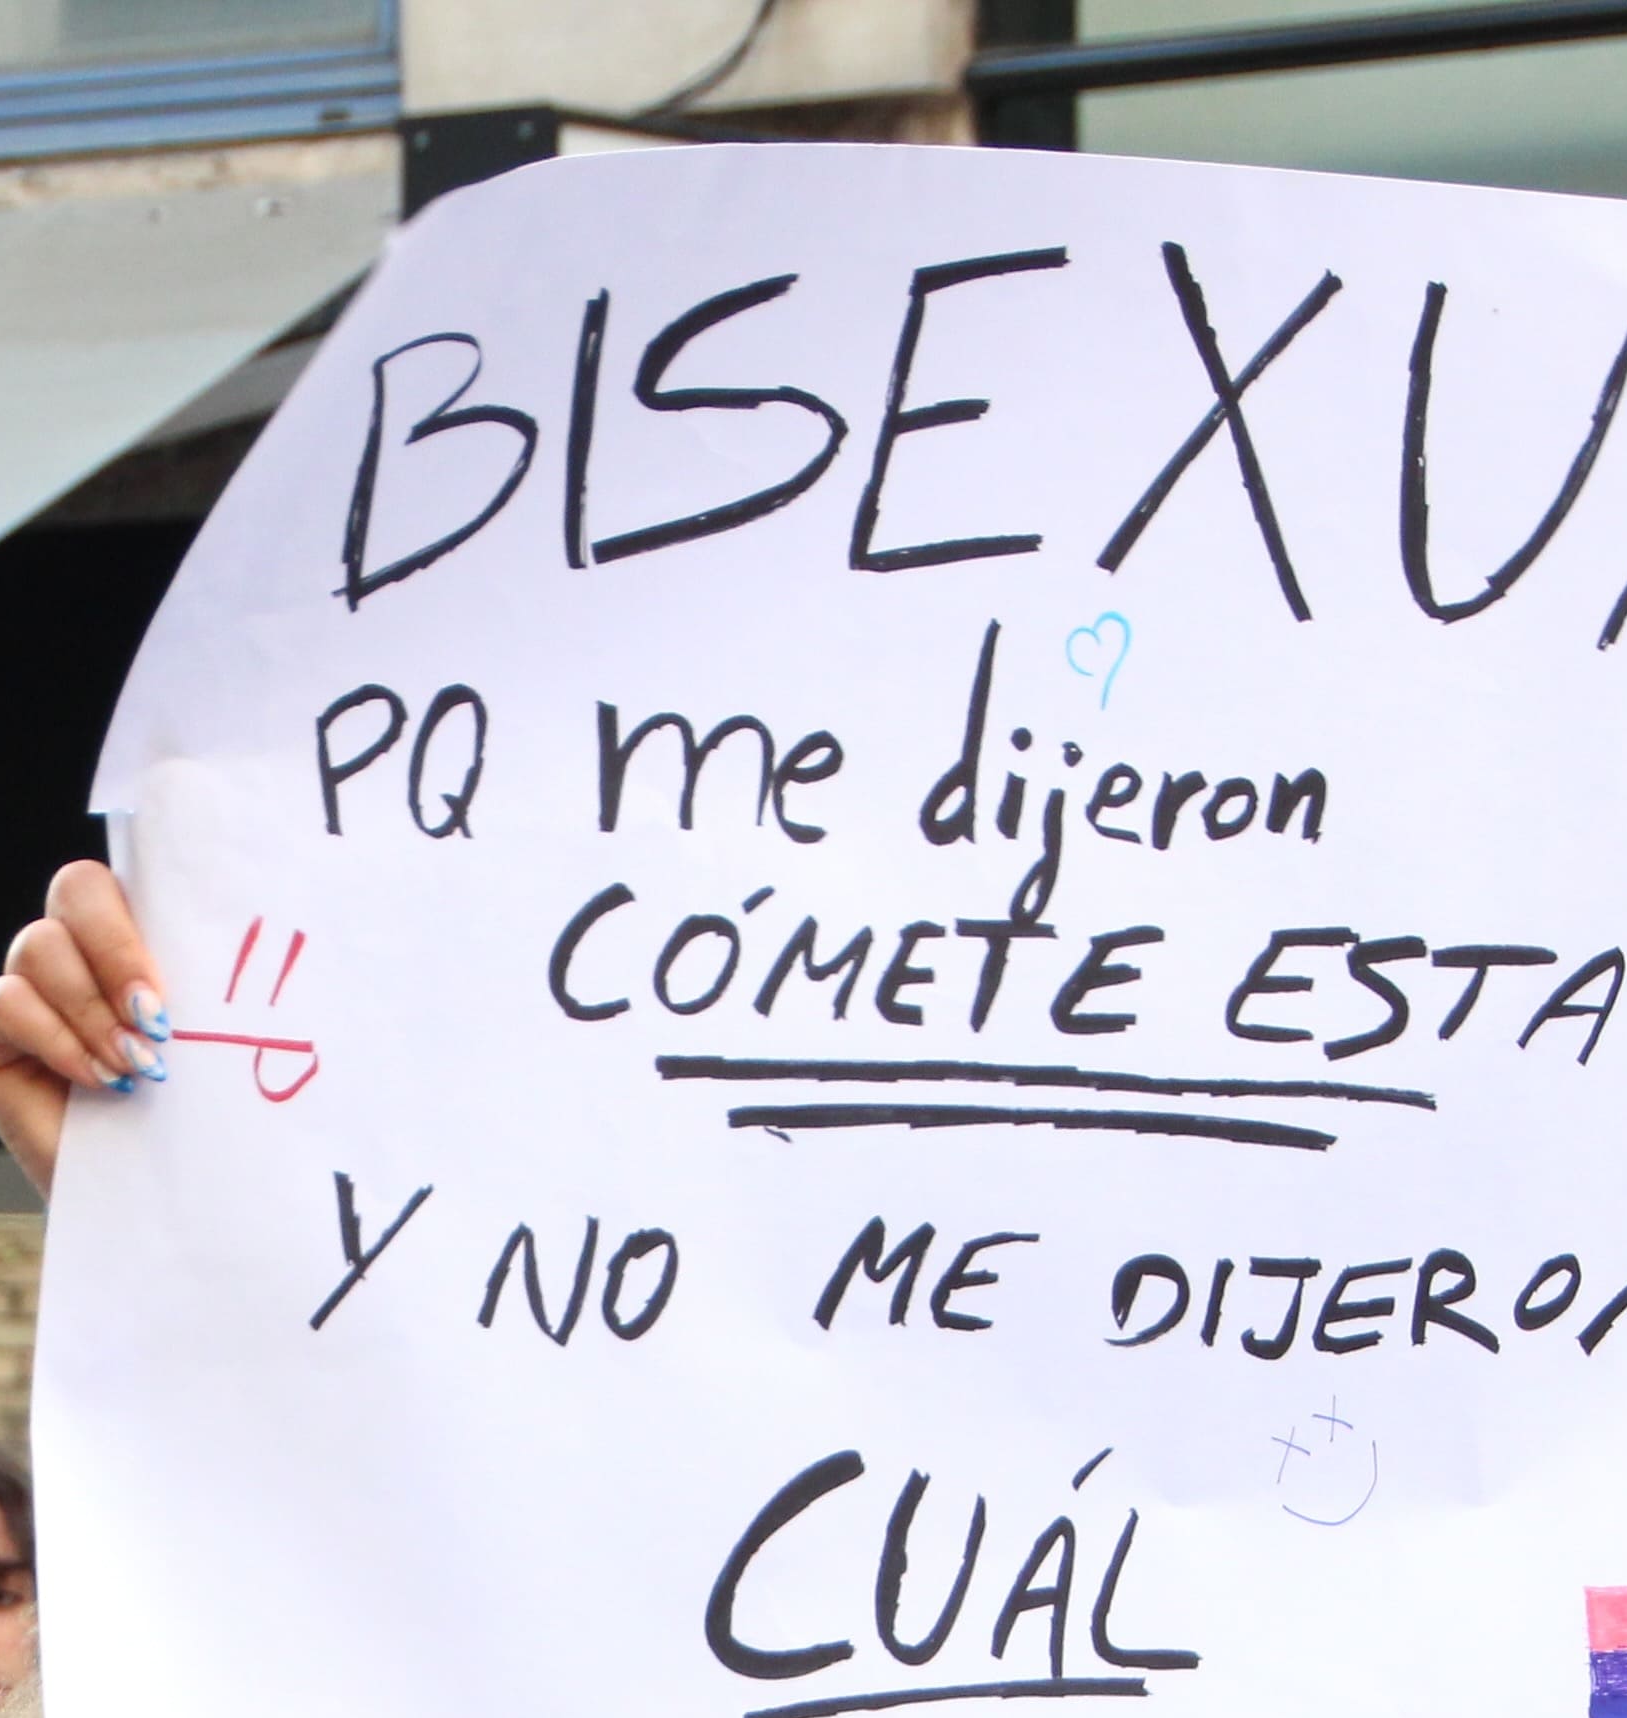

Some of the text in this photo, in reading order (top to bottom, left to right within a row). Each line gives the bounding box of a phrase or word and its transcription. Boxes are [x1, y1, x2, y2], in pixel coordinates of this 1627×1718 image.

[316, 620, 1328, 922] PQ me dijeron
[549, 884, 1626, 1066] CÓMETE ESTA
[310, 1173, 432, 1331] Y
[478, 1218, 678, 1347] NO
[814, 1217, 1039, 1332] ME
[705, 1448, 1200, 1680] CUÁL
